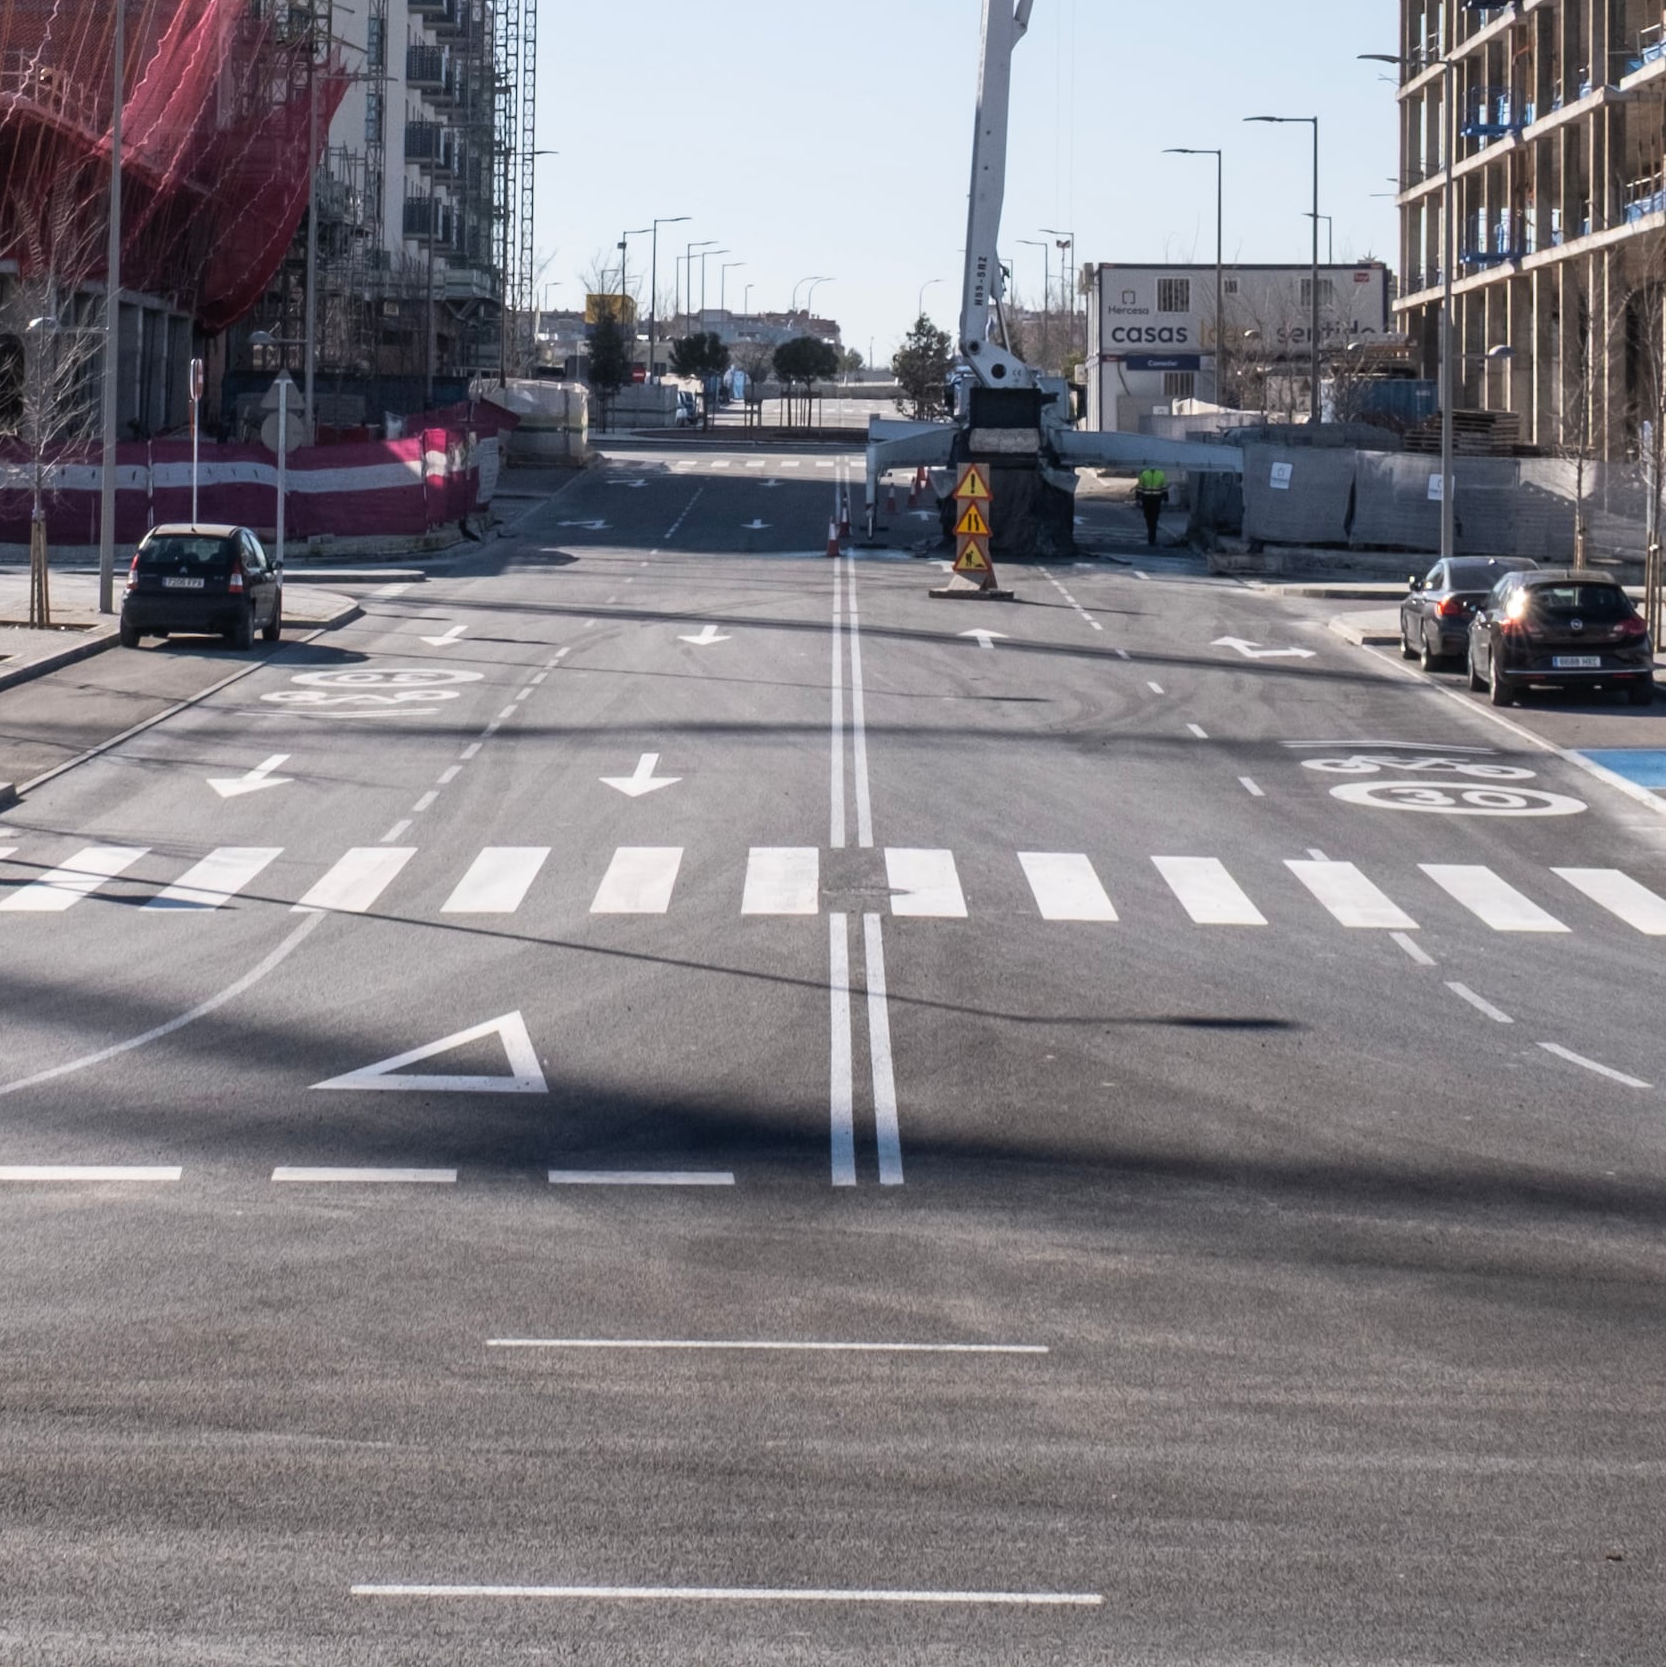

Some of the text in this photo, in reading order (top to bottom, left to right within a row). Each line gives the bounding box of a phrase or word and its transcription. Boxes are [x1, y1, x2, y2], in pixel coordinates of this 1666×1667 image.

[1108, 305, 1149, 315] Hercesa
[1111, 326, 1188, 343] casas
[1389, 788, 1528, 808] 30
